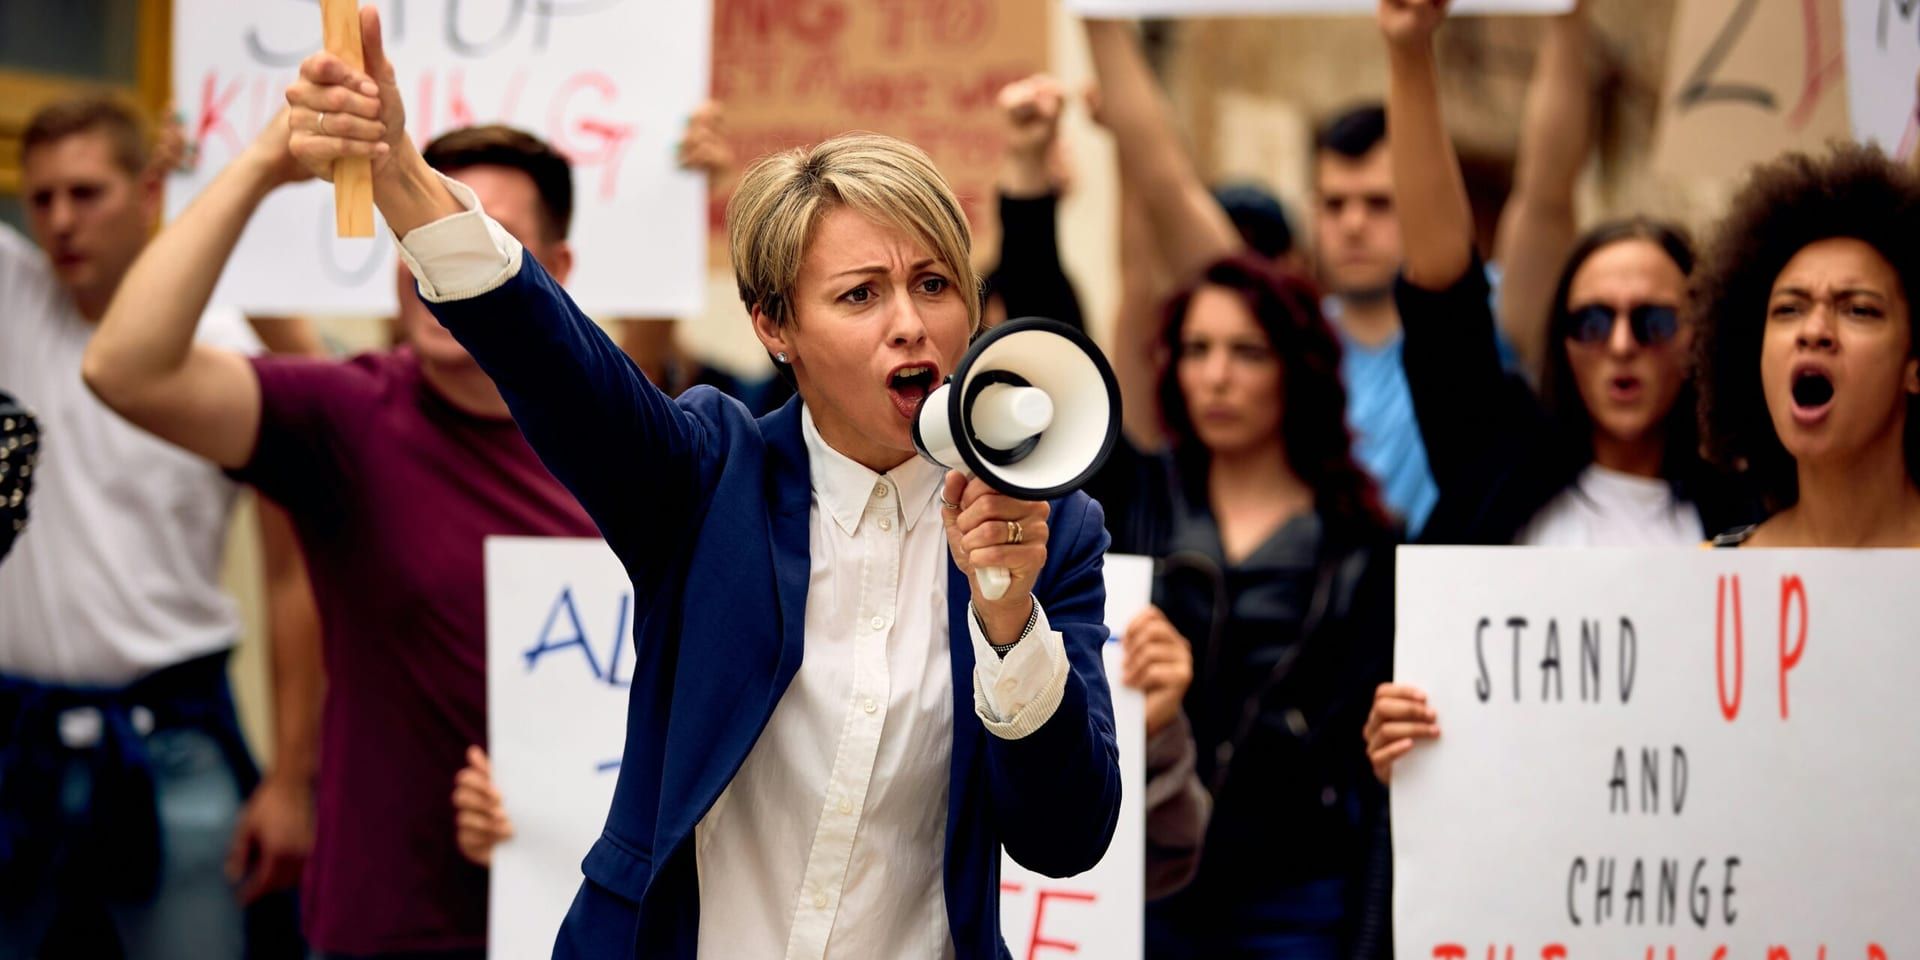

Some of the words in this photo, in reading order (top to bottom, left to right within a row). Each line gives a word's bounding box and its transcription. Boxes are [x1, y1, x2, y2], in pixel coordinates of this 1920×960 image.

[197, 67, 637, 202] KIING
[1475, 615, 1637, 704] STAND
[1713, 573, 1809, 724] UP
[1608, 745, 1689, 816] AND
[1566, 854, 1743, 930] CHANGE
